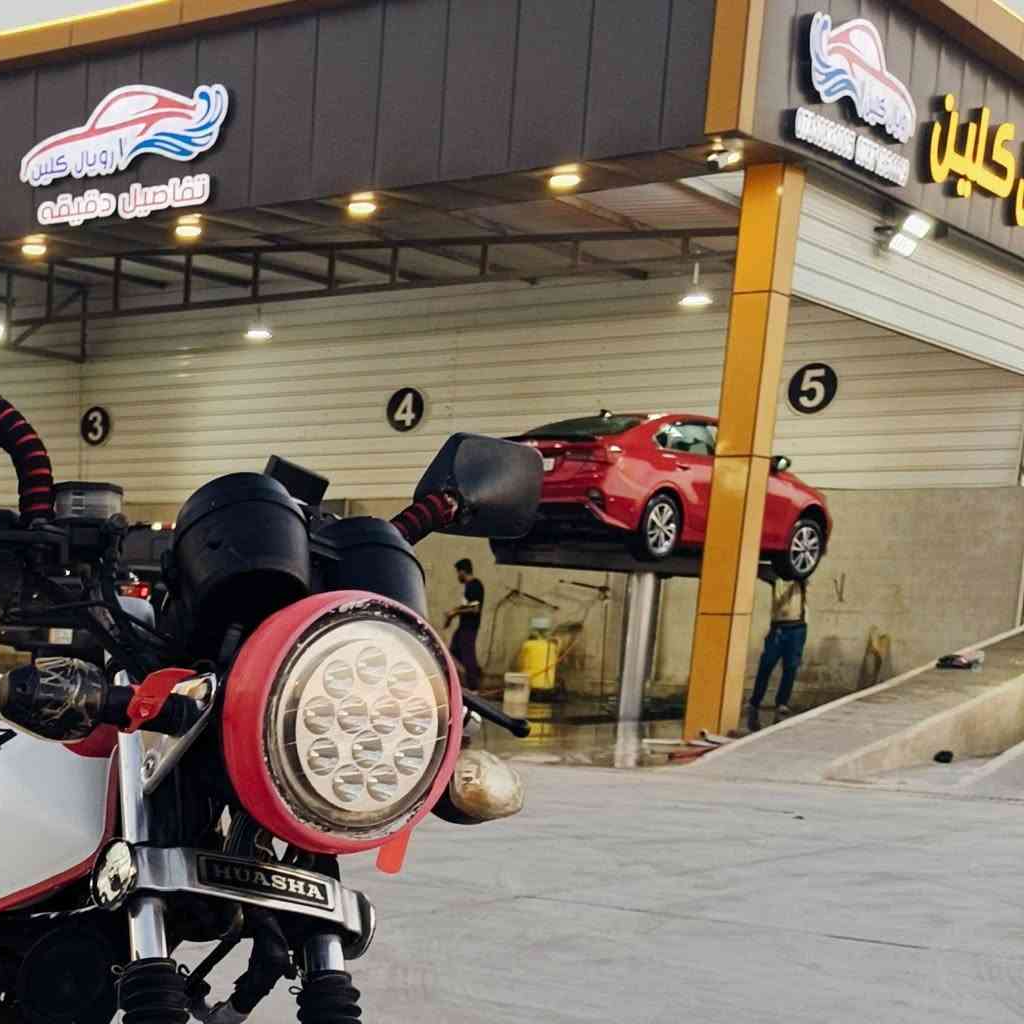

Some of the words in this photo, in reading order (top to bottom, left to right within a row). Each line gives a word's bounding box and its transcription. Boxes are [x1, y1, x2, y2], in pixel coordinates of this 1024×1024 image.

[930, 93, 1016, 198] كلين
[32, 153, 69, 182] كلين
[39, 190, 115, 225] دقيقه
[119, 174, 208, 217] تفاصيل
[797, 367, 827, 408] 5
[86, 410, 104, 441] 3
[393, 392, 415, 427] 4
[213, 862, 325, 901] HUASHA
